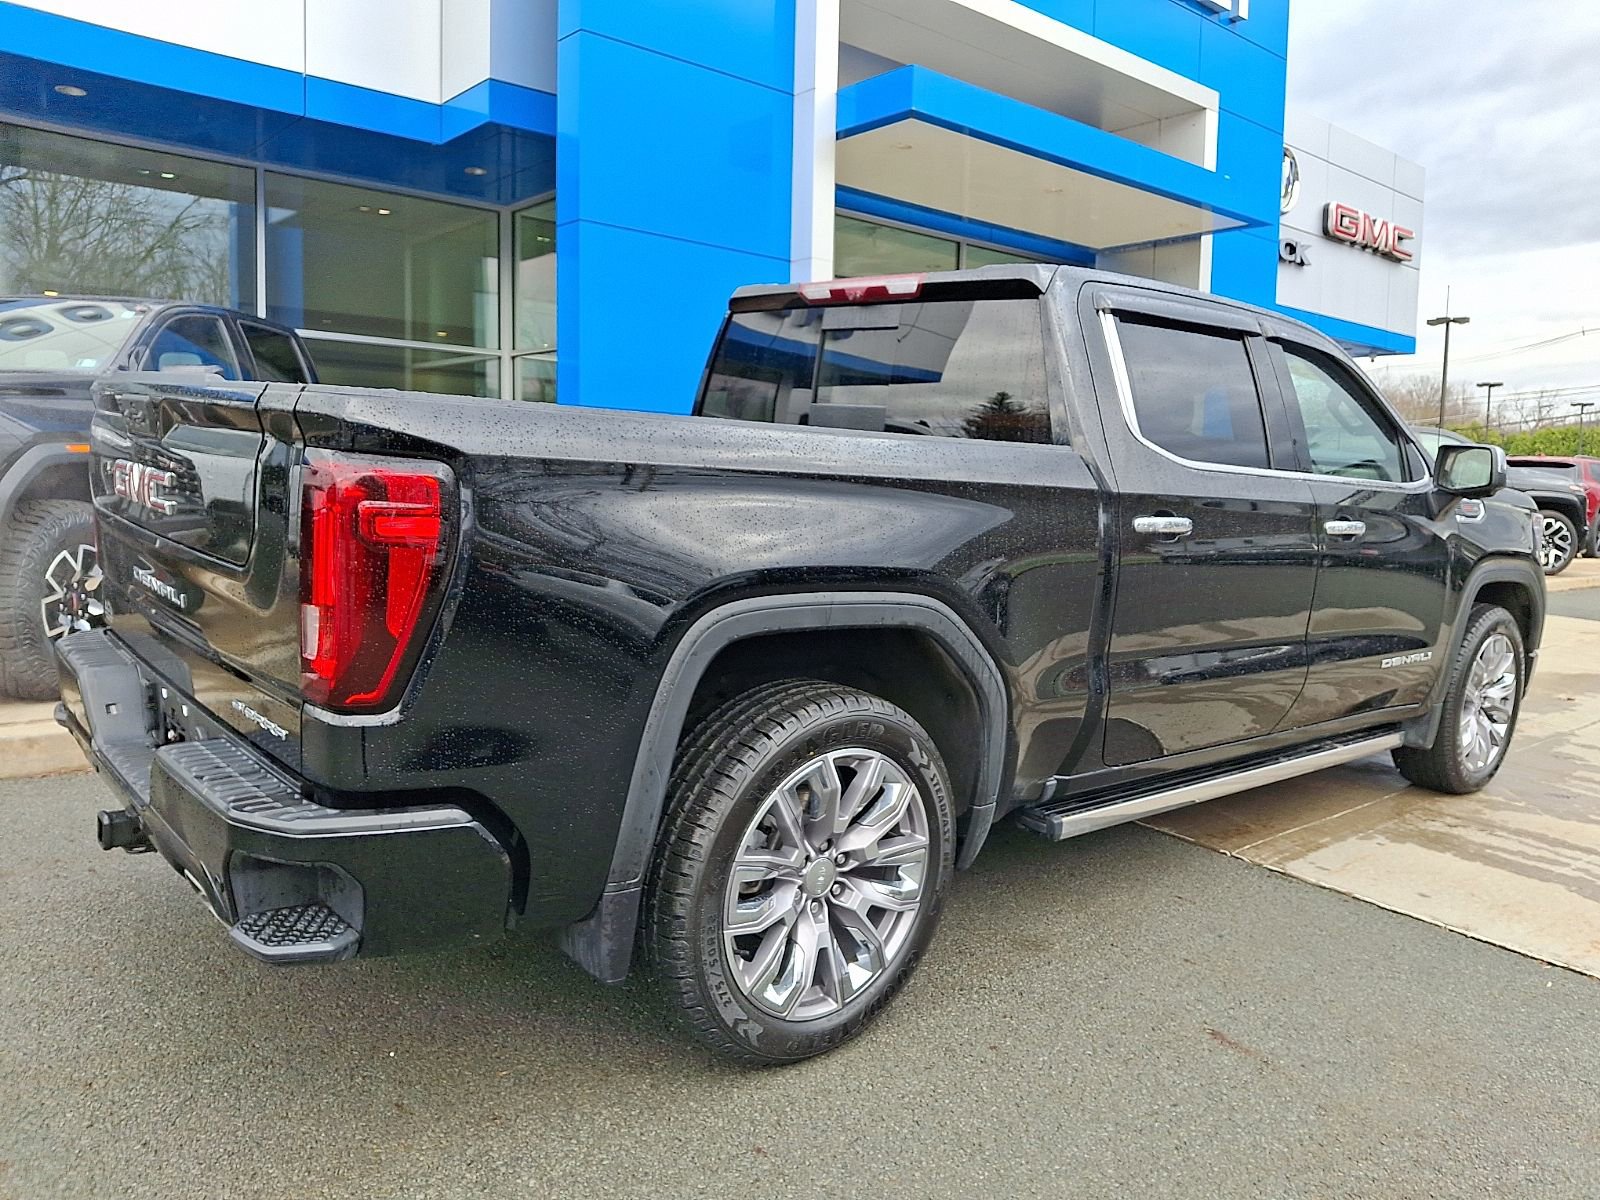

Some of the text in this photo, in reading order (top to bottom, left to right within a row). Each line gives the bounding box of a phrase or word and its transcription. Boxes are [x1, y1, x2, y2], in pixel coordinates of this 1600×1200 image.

[1325, 201, 1415, 263] GMC
[113, 459, 177, 515] GMC
[1381, 651, 1433, 669] DENALI
[929, 772, 950, 844] STEADFAST
